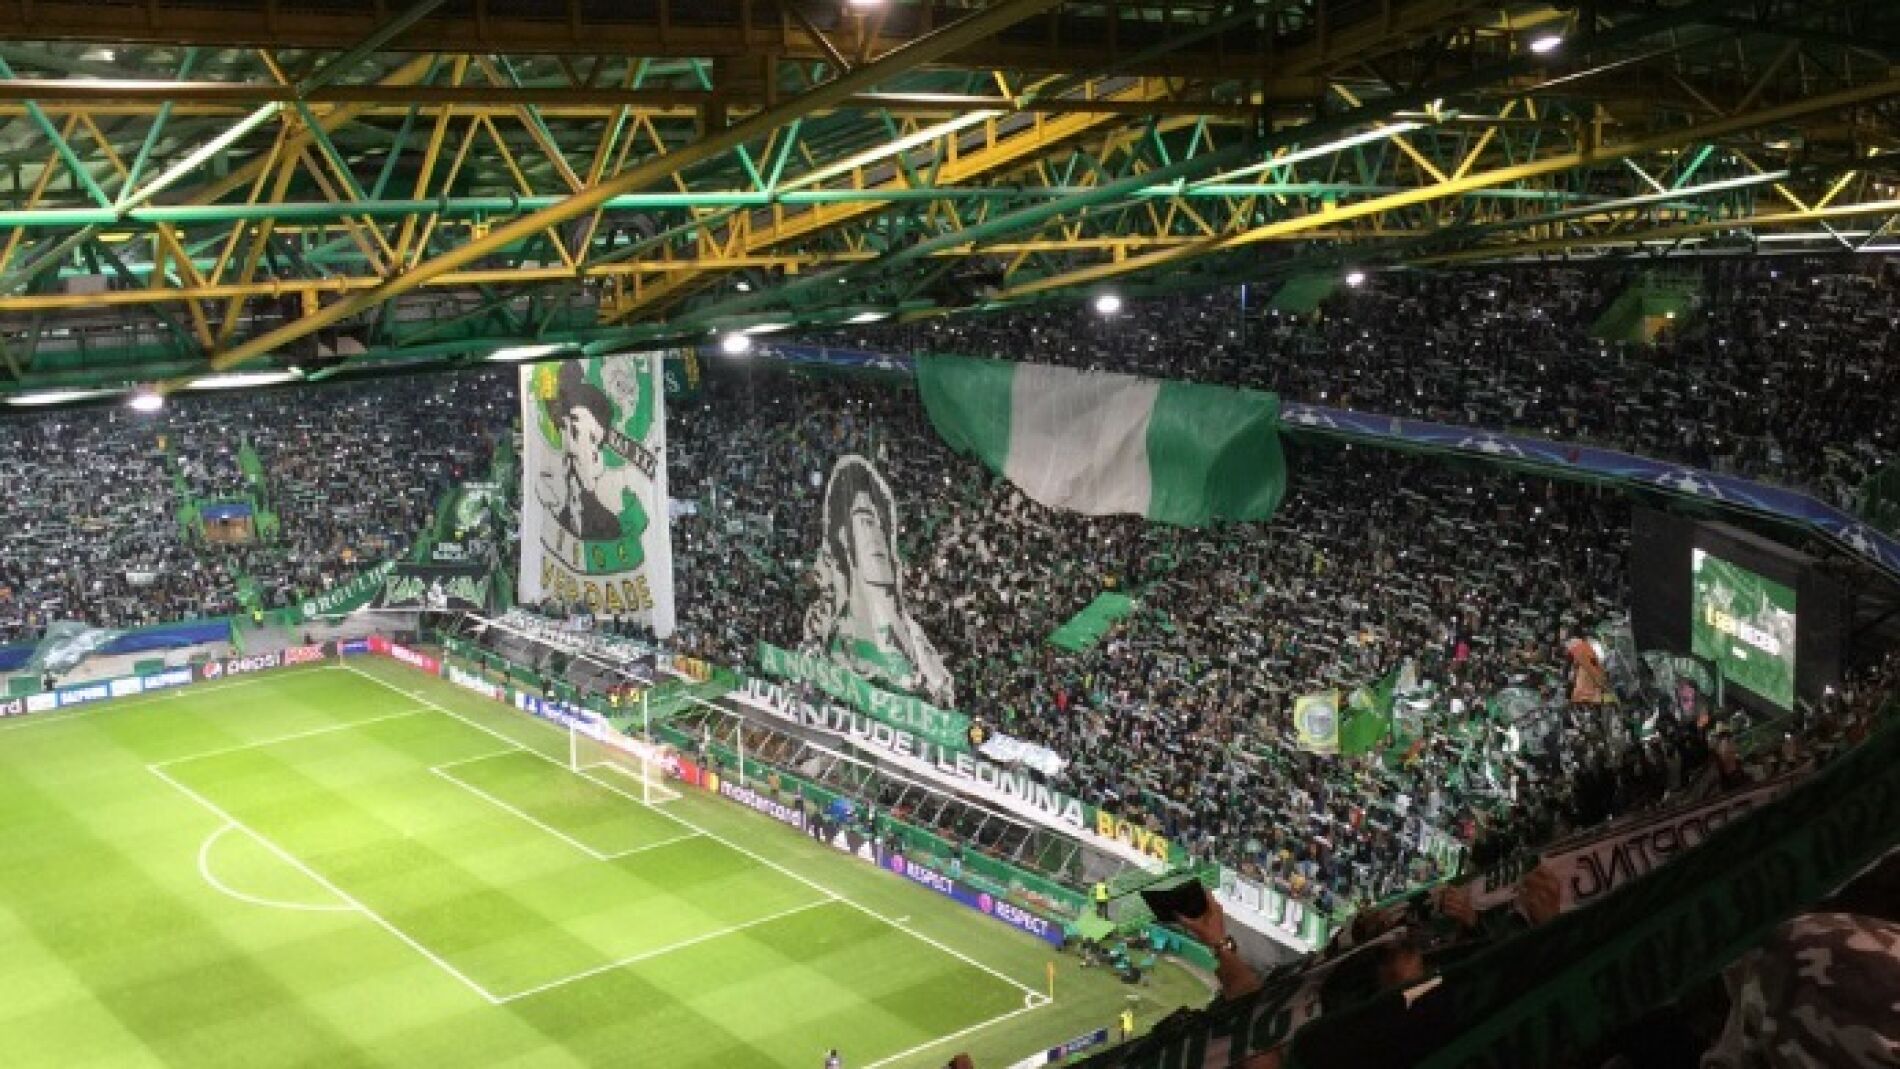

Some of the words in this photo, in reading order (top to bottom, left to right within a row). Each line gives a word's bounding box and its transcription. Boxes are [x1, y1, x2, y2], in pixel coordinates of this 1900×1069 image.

[227, 650, 280, 675] pepsi
[938, 745, 1085, 829] LEONINA
[1096, 808, 1169, 866] BOYS
[907, 861, 953, 895] RESPECT
[995, 901, 1049, 936] RESPECT
